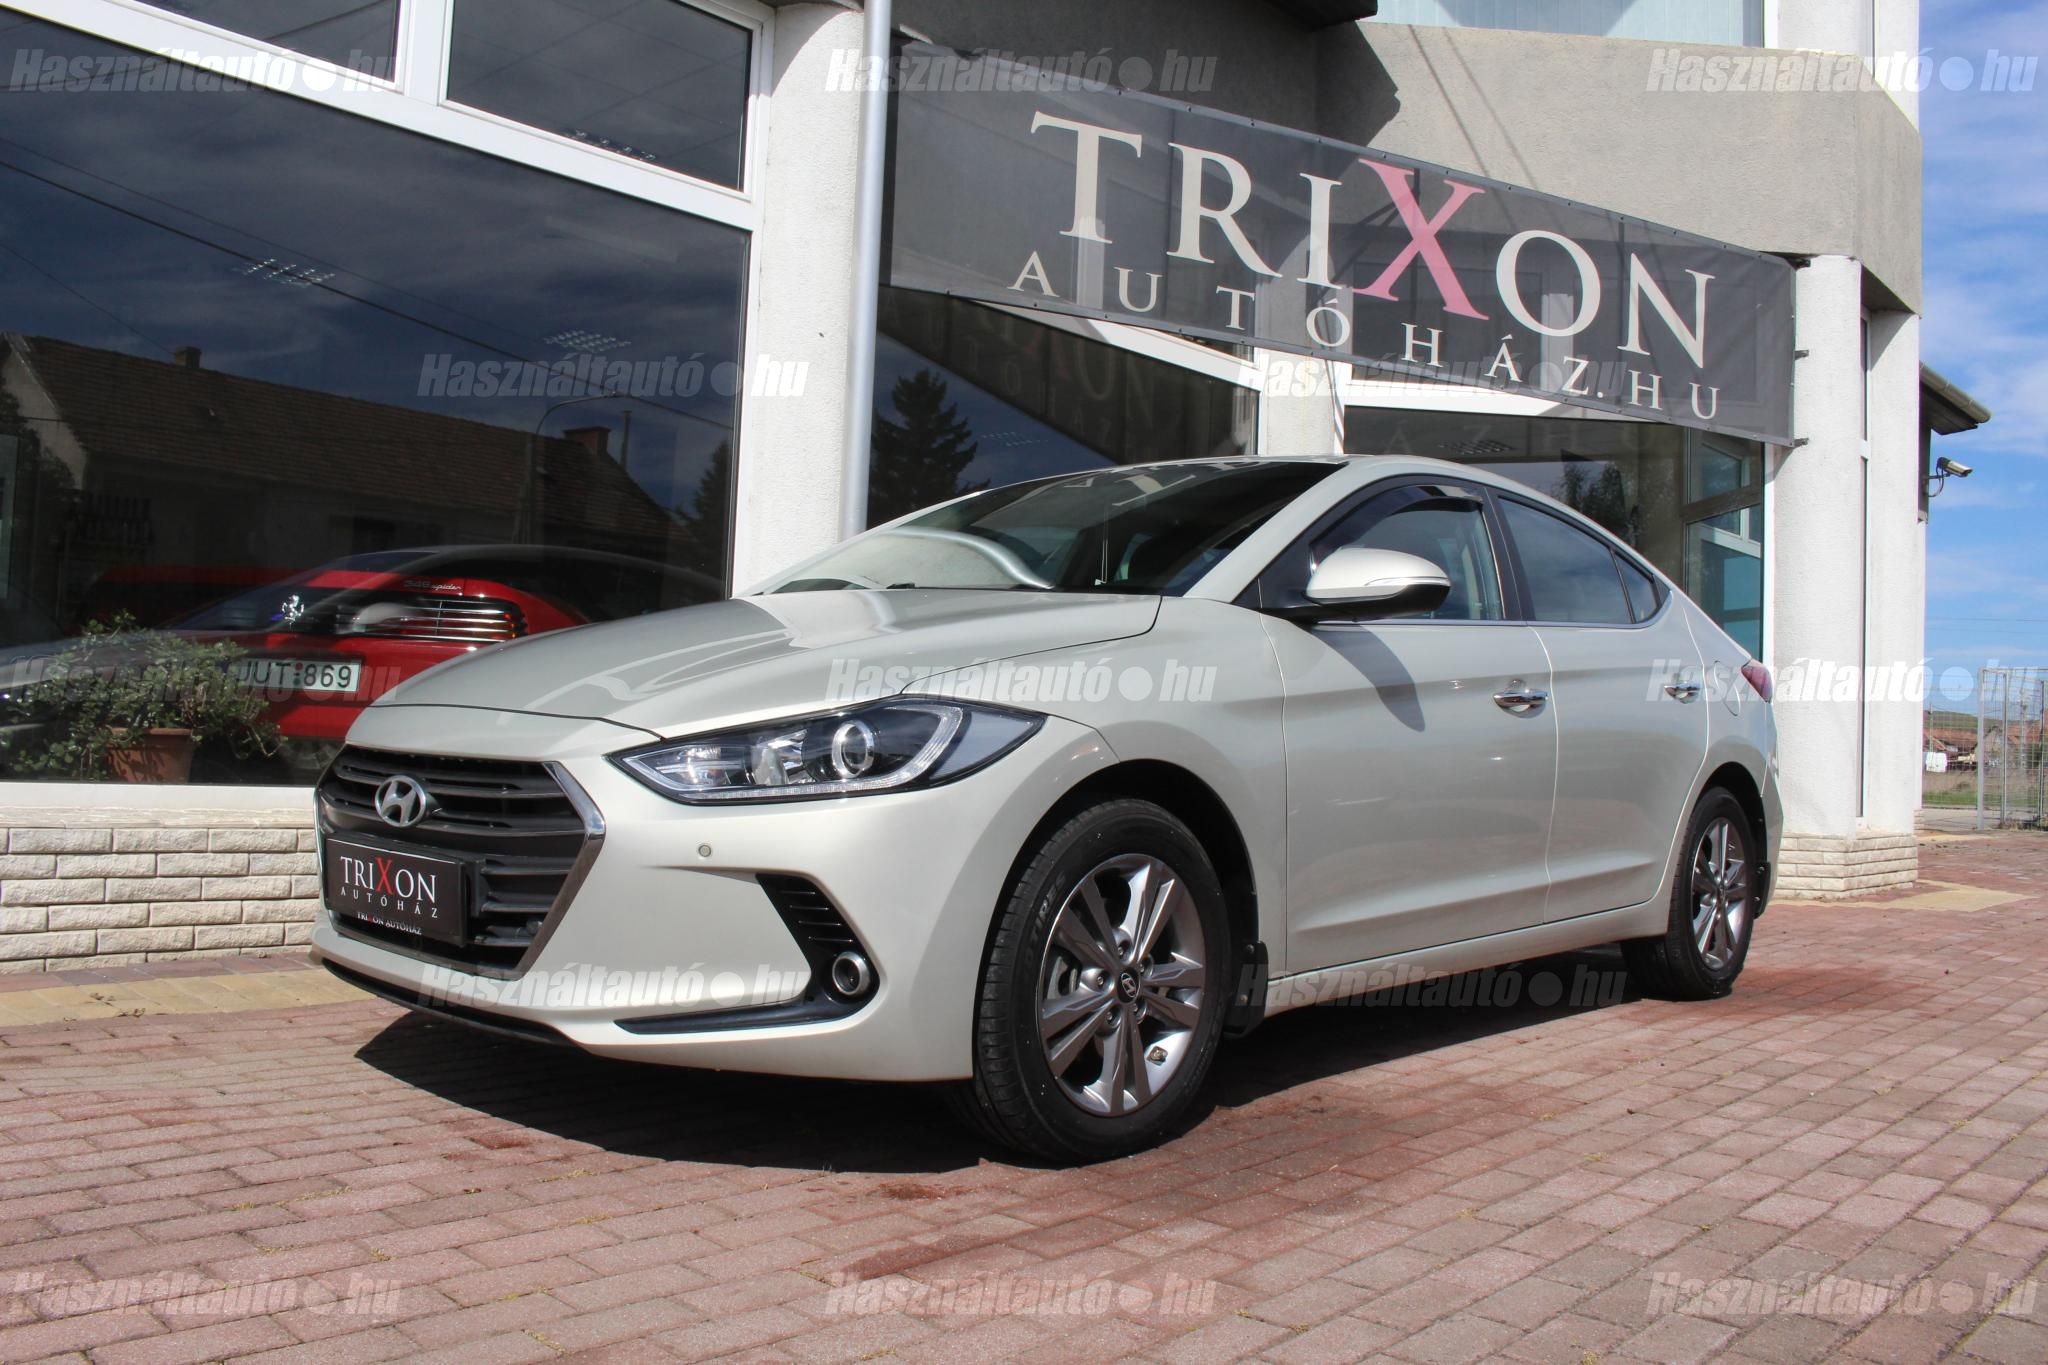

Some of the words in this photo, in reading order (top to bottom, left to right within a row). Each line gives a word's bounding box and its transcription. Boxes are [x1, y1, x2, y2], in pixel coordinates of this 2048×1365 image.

[1030, 110, 1715, 369] TRIXON
[340, 856, 437, 904] TRIXON
[340, 886, 438, 919] AUTÓHÁZ
